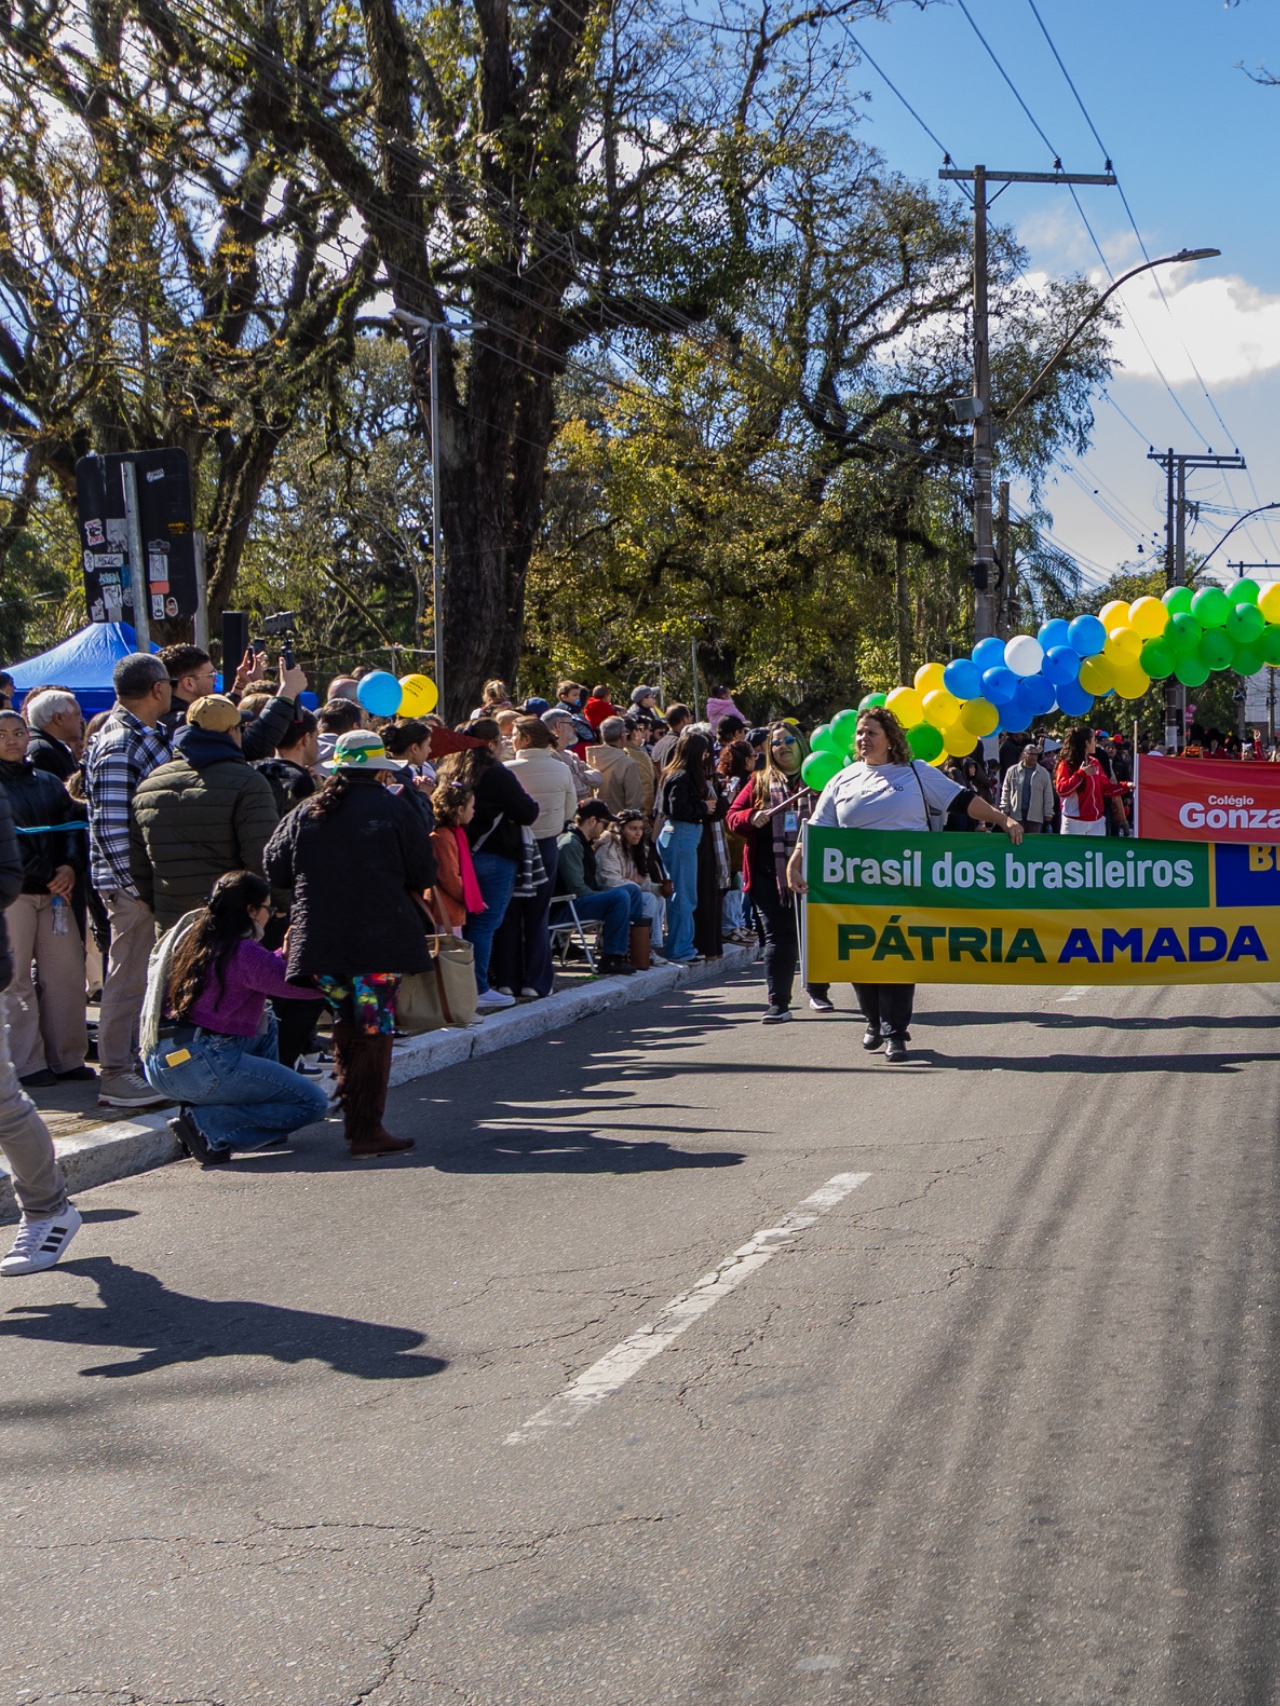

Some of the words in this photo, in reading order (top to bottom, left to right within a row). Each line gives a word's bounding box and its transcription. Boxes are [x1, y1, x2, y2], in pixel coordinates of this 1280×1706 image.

[1208, 795, 1254, 807] Colégio
[823, 848, 922, 887] Brasil
[932, 852, 996, 888] dos
[1006, 850, 1194, 889] brasileiros
[837, 915, 1047, 963] PÁTRIA
[1057, 925, 1270, 963] AMADA
